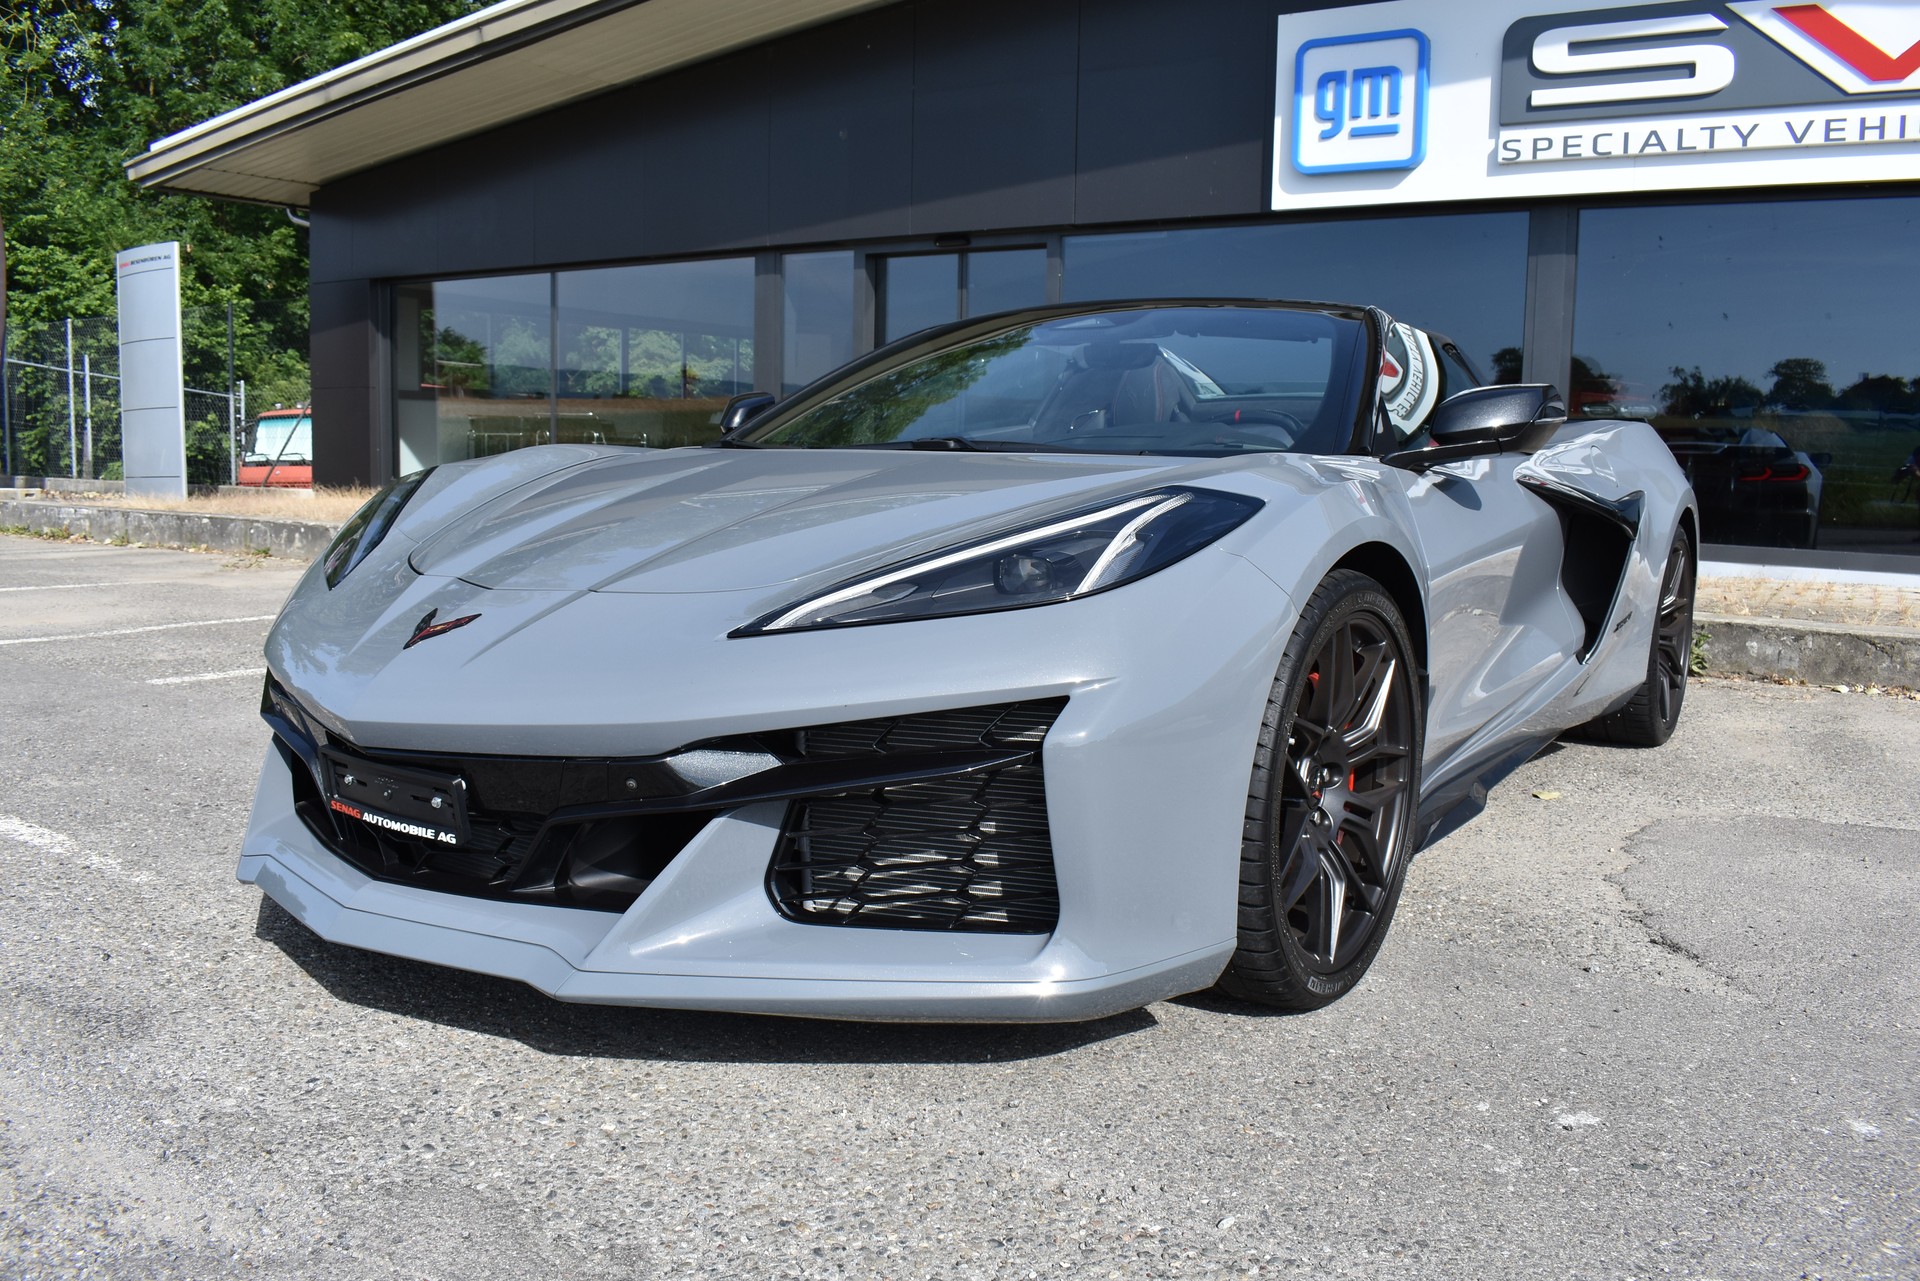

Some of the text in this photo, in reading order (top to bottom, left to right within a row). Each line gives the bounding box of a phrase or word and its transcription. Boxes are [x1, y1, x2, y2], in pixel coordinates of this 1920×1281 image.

[1316, 64, 1402, 140] gm
[1501, 115, 1920, 162] SPECIALTY VEHI
[331, 800, 457, 844] SENAG AUTOMOBILE AG
